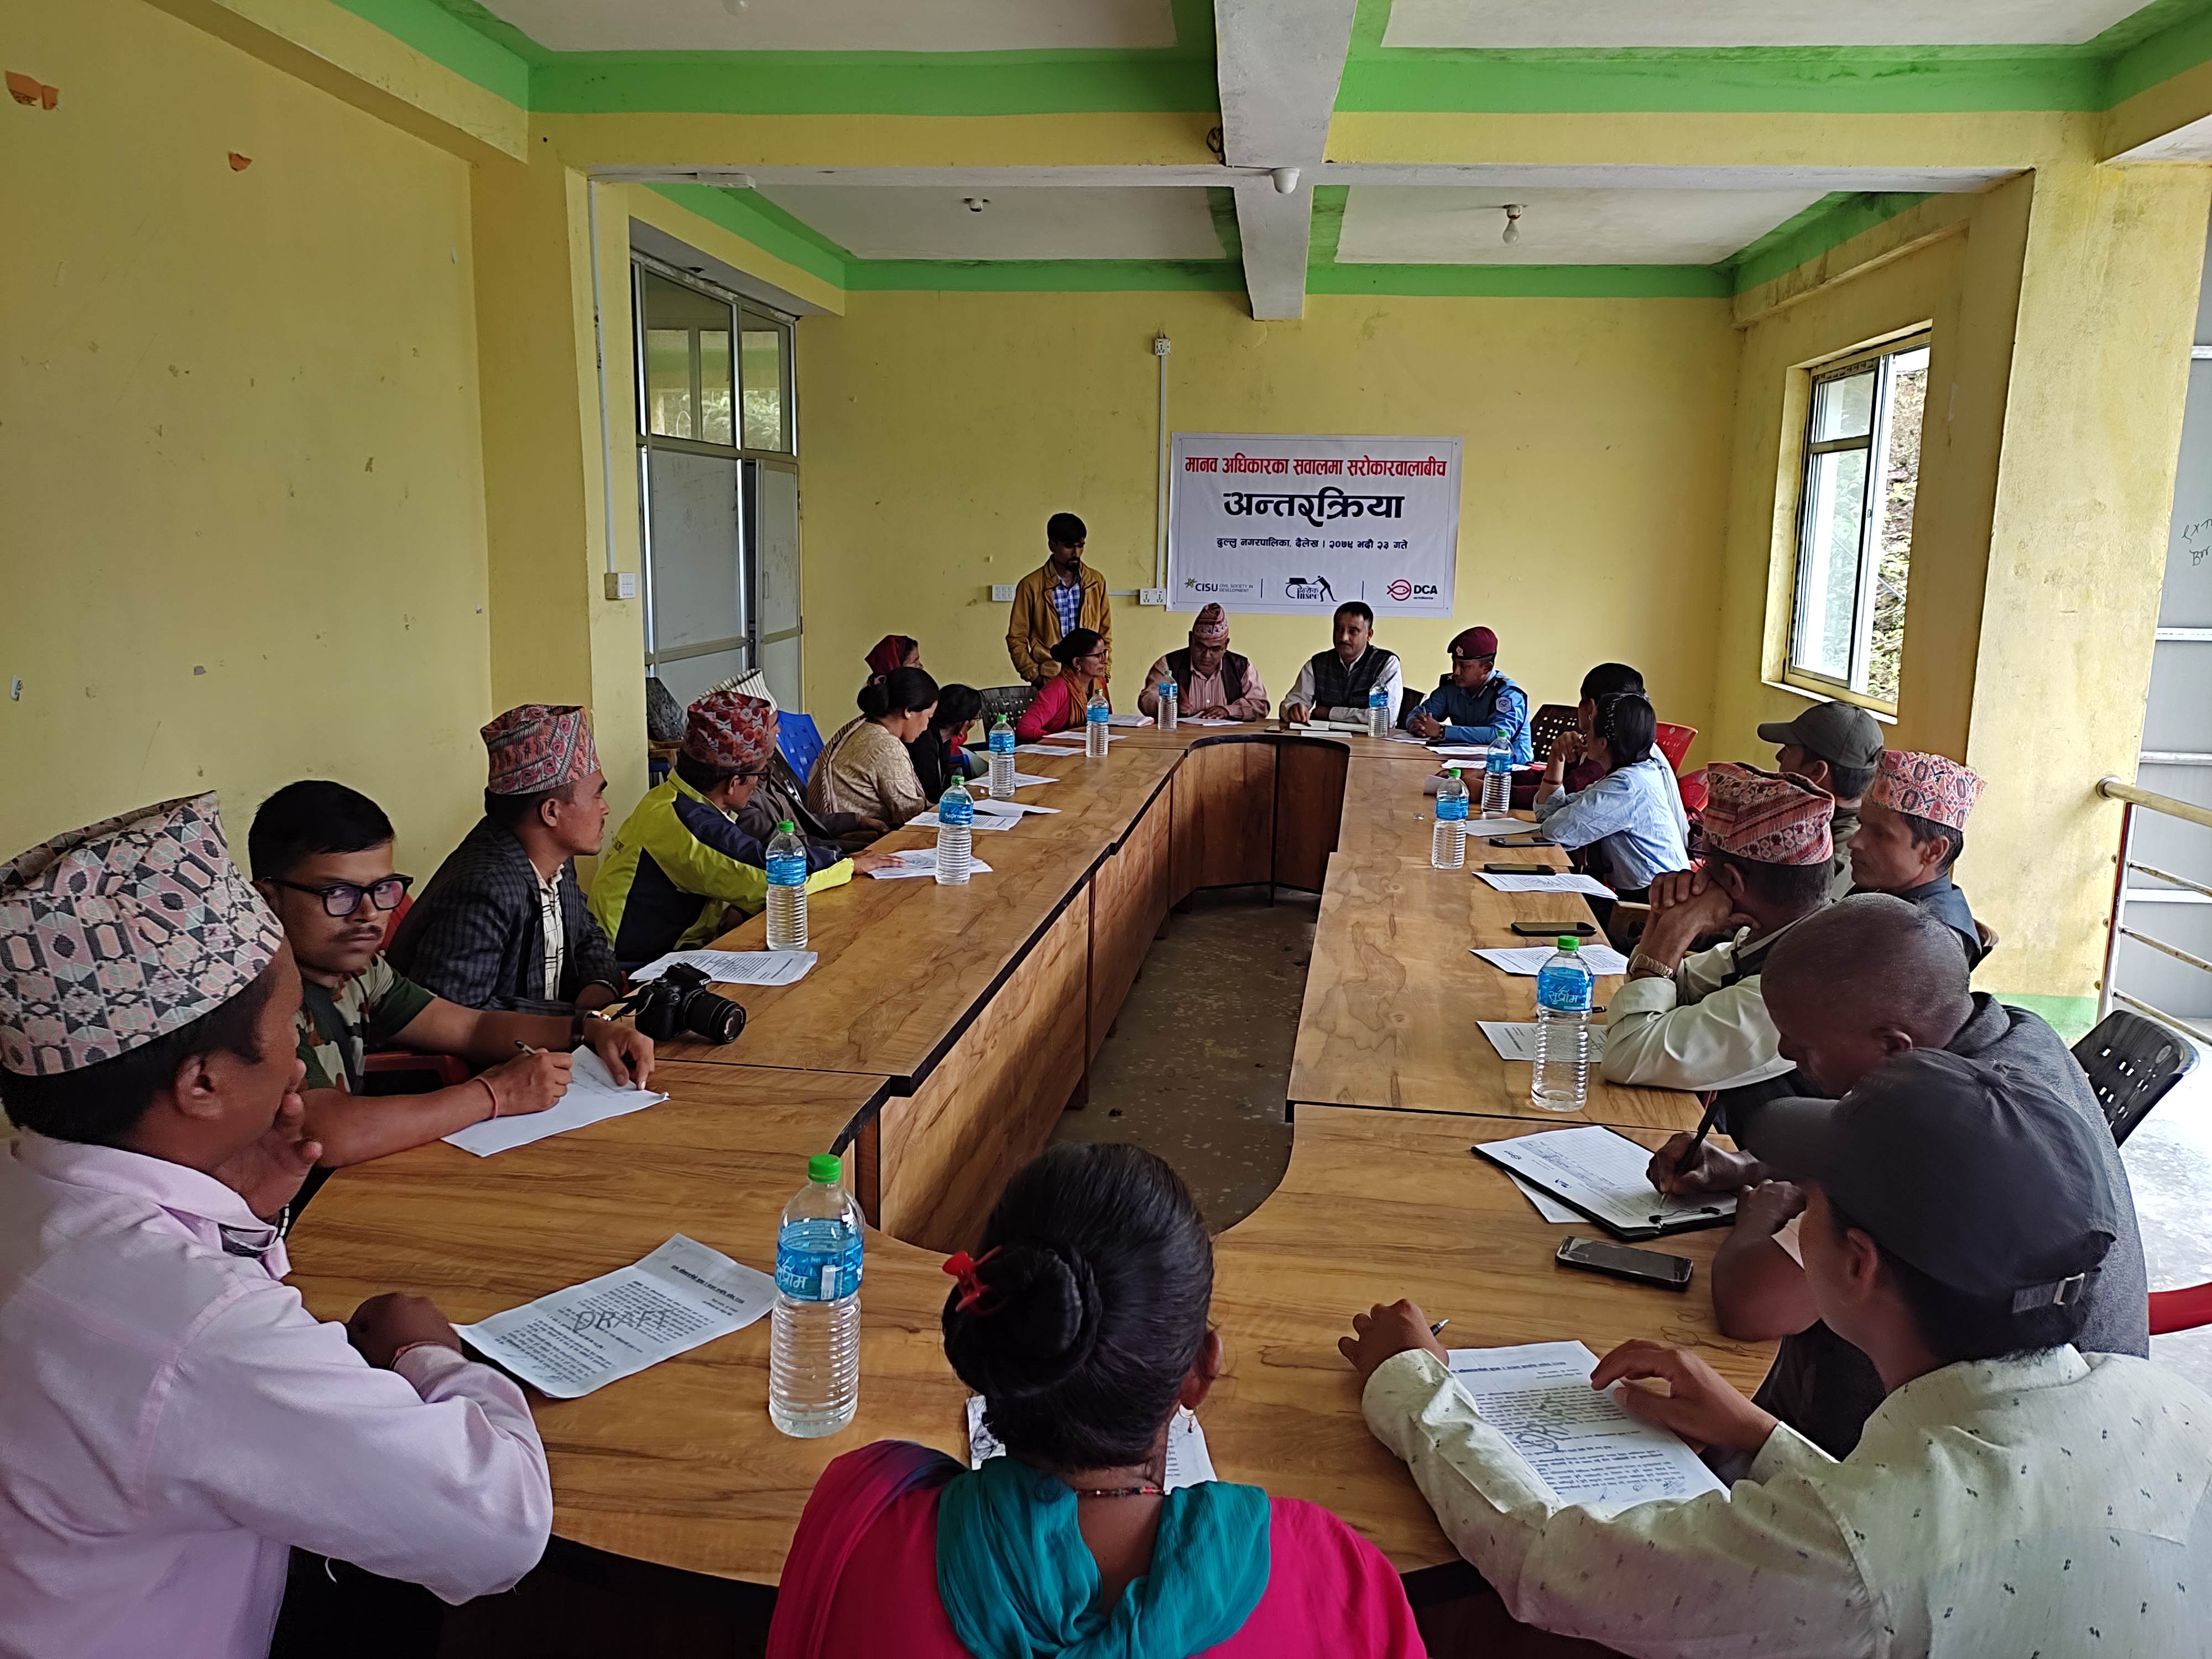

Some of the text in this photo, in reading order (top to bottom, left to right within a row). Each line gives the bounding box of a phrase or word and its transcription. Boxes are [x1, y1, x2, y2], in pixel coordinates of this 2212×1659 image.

[1185, 452, 1447, 477] मानव अधिकारका सवालमा सरोकारवालाबीच
[1223, 486, 1405, 528] अन्तरक्रिया
[1217, 538, 1238, 549] दुल्लु
[1240, 536, 1292, 548] नगरपालिका,
[1295, 537, 1319, 548] दैलेख
[1377, 541, 1389, 550] २३
[1393, 539, 1408, 549] गते
[1195, 583, 1218, 592] CISU
[1413, 585, 1438, 594] DCA
